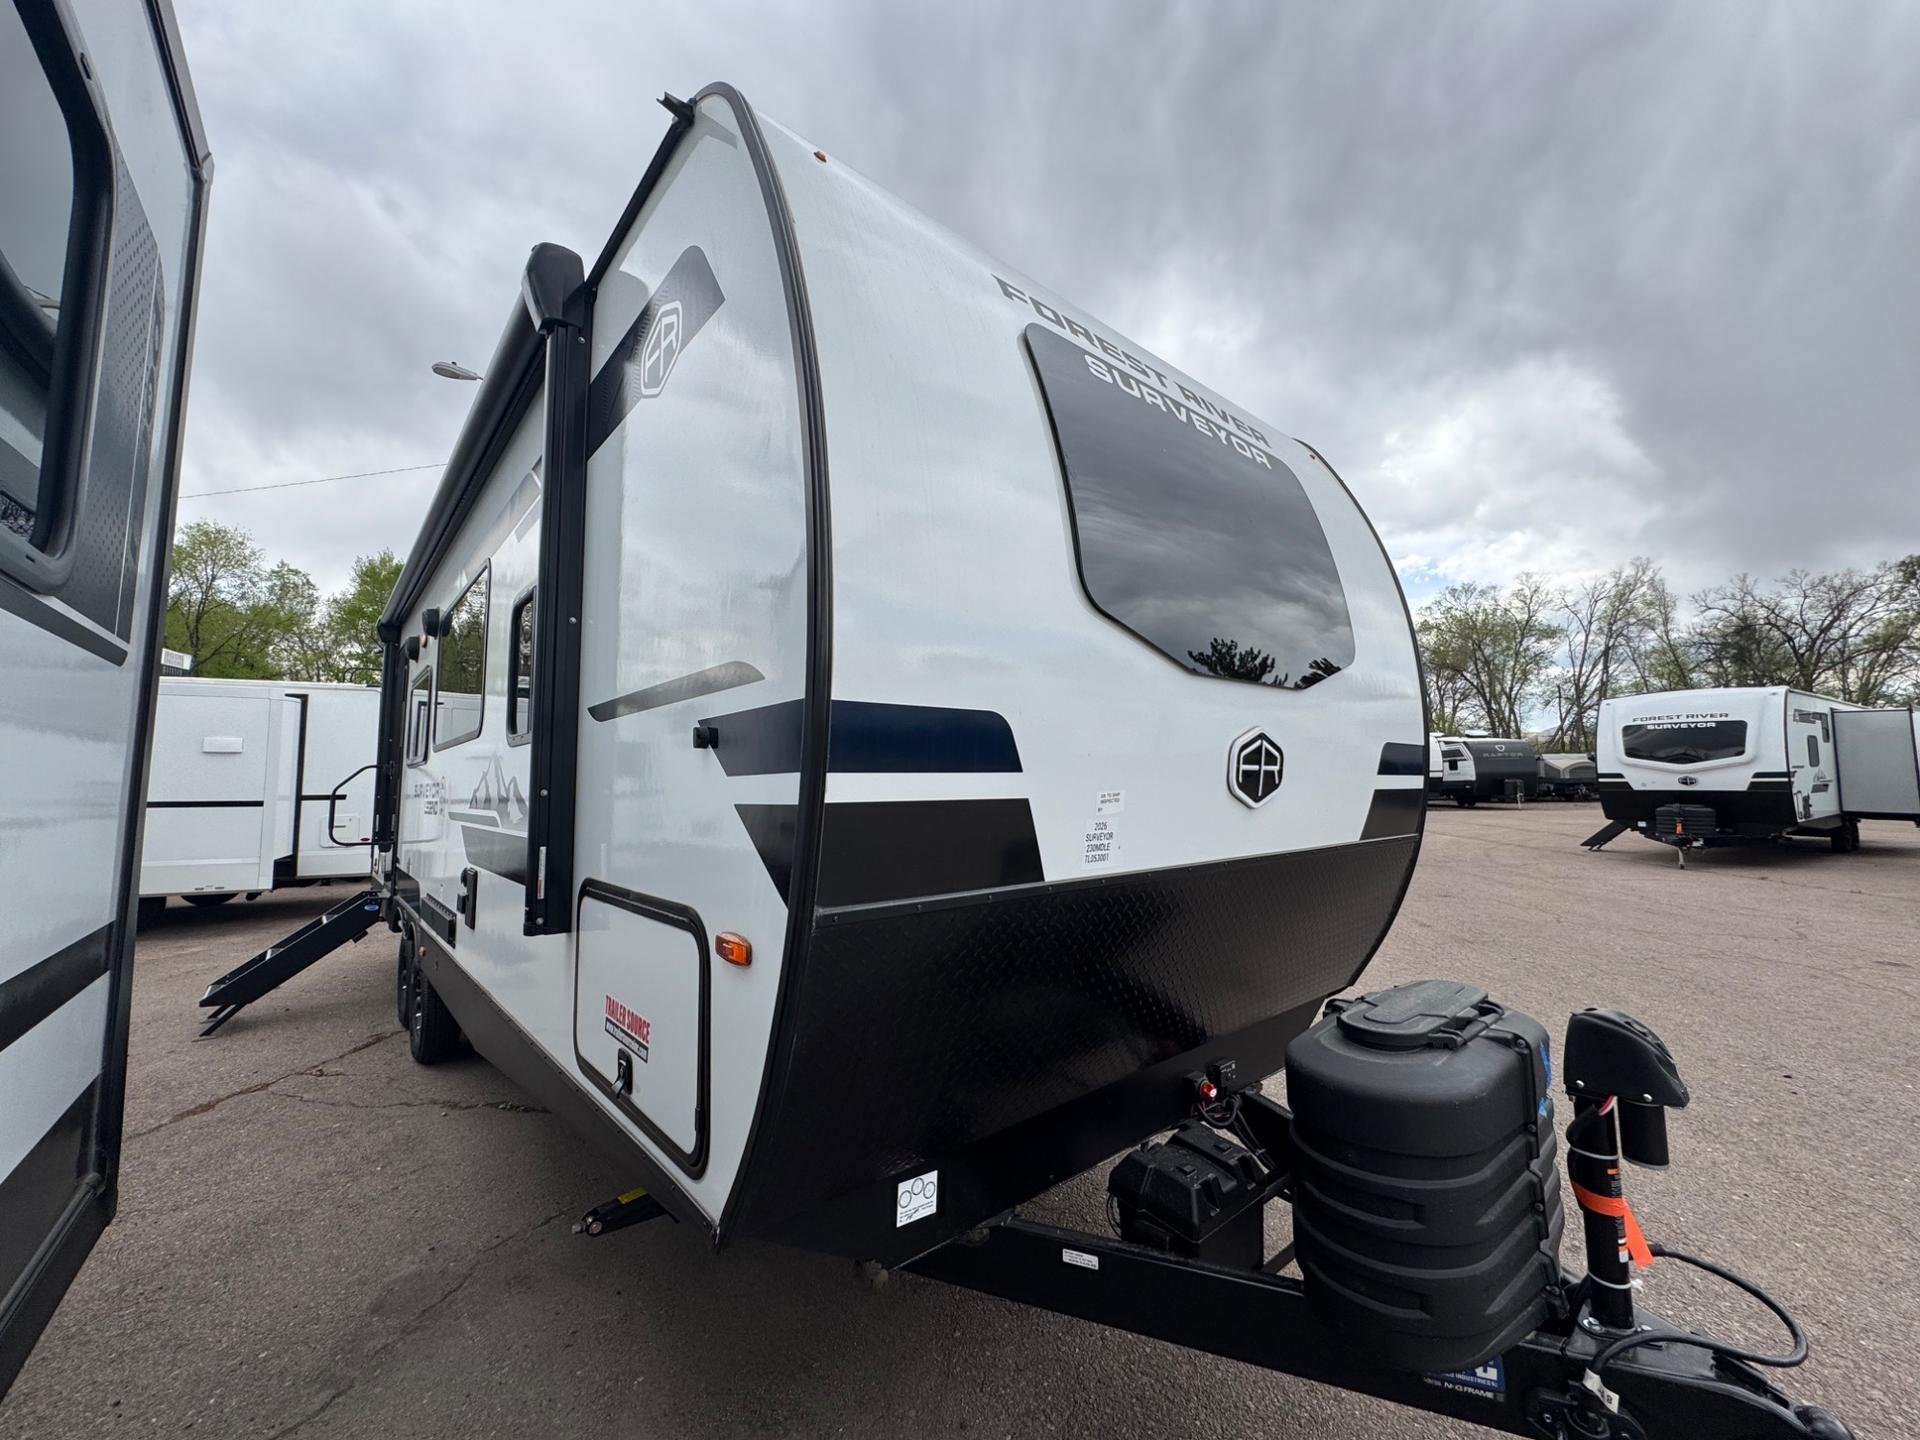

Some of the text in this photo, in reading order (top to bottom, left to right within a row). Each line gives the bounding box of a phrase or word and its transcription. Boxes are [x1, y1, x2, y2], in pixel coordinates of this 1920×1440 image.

[990, 273, 1272, 449] FOREST RIVER
[1084, 354, 1272, 470] SURVEYOR
[1632, 714, 1682, 723] FOREST
[1647, 722, 1716, 730] SURVEYOR
[1085, 831, 1114, 842] SURVEYOR
